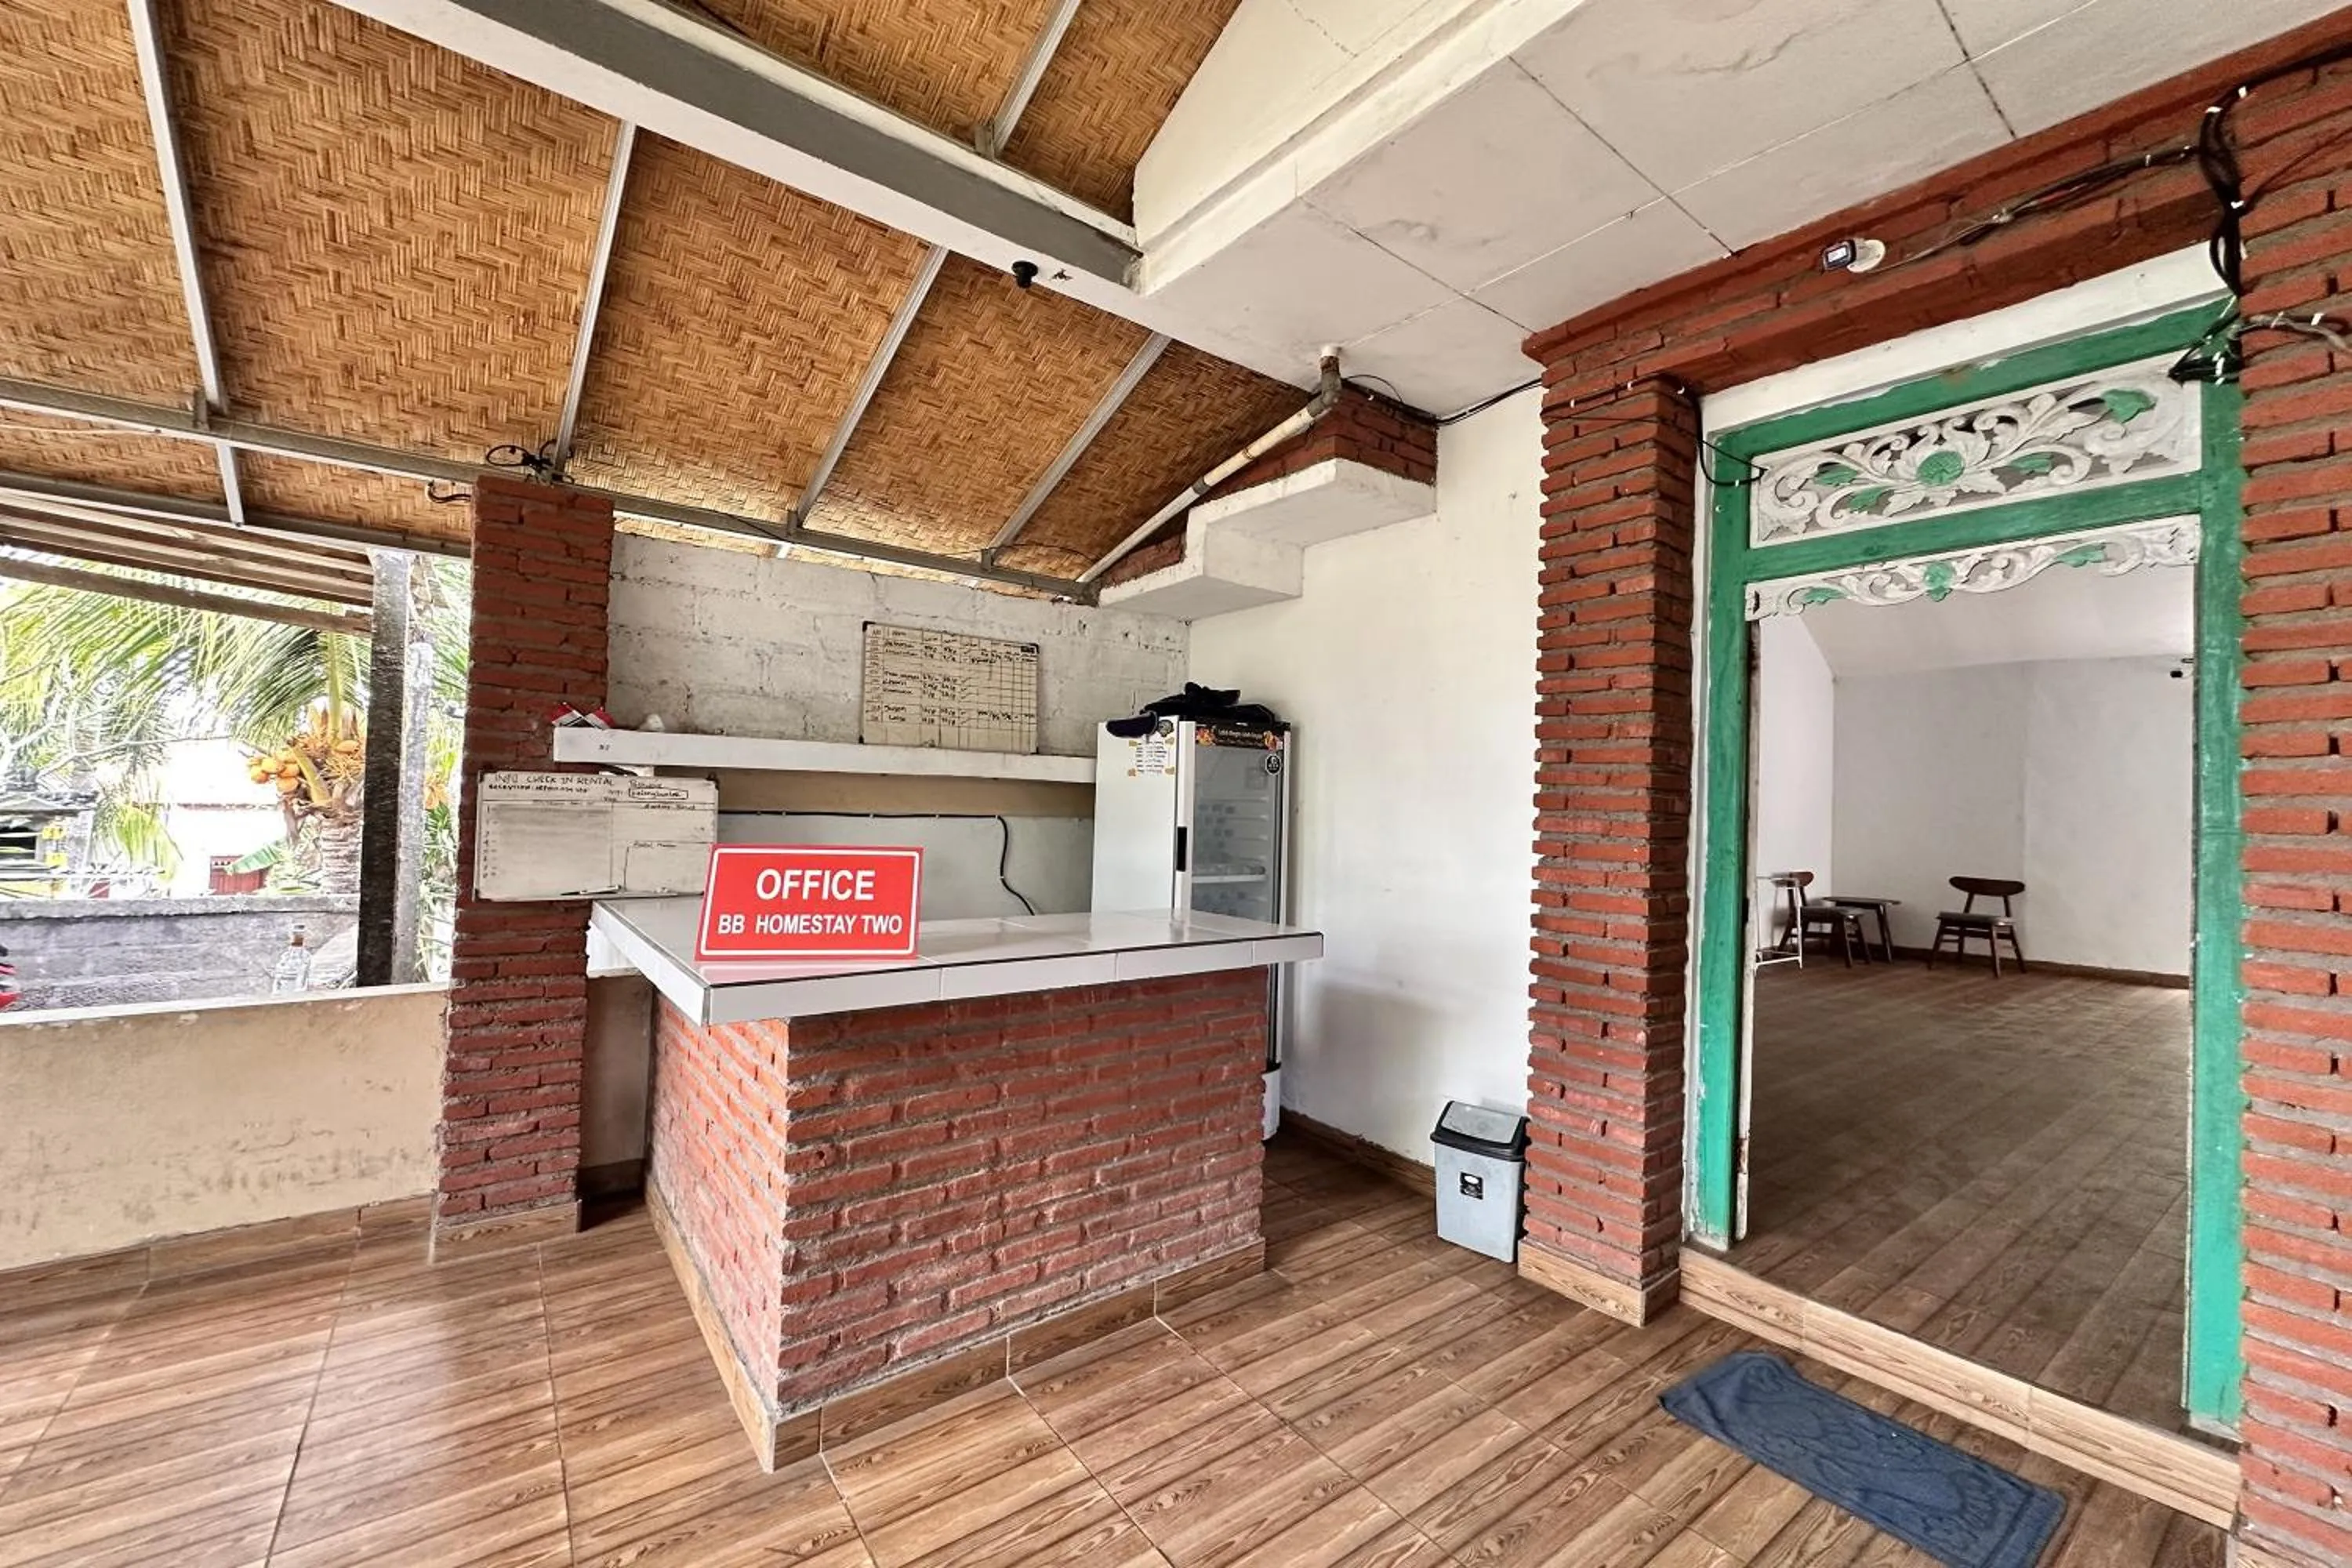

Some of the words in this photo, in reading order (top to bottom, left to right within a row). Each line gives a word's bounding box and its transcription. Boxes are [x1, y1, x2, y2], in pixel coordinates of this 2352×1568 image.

[577, 778, 614, 786] RENTAL
[756, 868, 876, 901] OFFICE
[717, 913, 745, 935] BB
[755, 913, 856, 935] HOMESTAY
[861, 913, 902, 935] TWO
